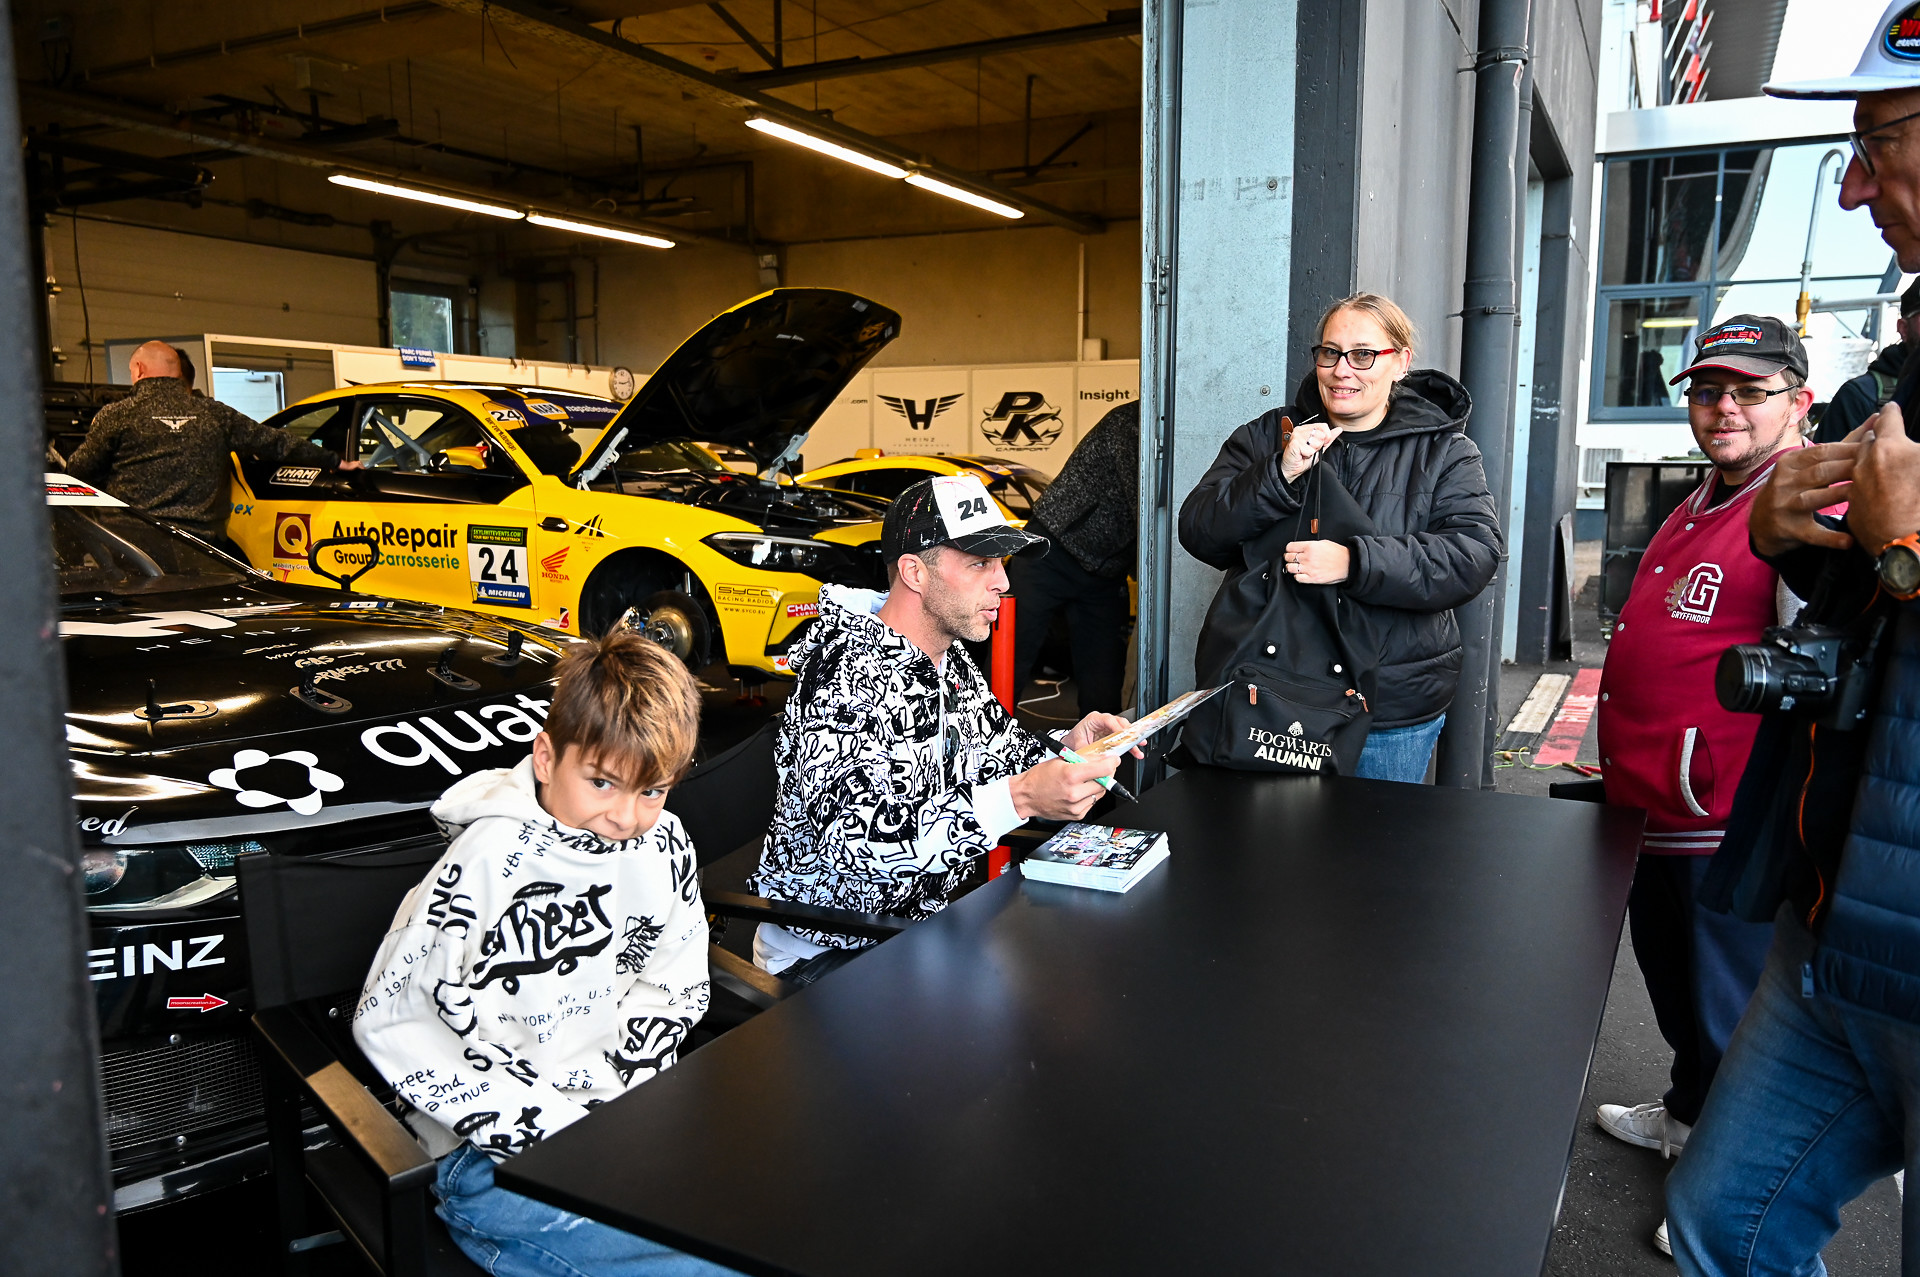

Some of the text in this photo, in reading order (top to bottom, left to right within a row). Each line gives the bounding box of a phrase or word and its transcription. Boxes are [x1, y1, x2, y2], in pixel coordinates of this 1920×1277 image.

[490, 409, 524, 422] 24
[276, 468, 319, 480] UMAMI
[957, 497, 988, 521] 24
[332, 520, 458, 552] AutoRepair
[378, 551, 460, 570] Carrosserie
[478, 546, 519, 584] 24
[541, 571, 570, 581] HONDA
[488, 588, 526, 599] MICHELIN
[1677, 562, 1724, 617] G
[1671, 610, 1711, 625] GRYFFINDOR
[295, 655, 335, 668] GAS
[1247, 727, 1332, 757] HOGWARTS
[1254, 744, 1323, 771] ALUMNI
[81, 806, 139, 836] ed
[425, 1081, 490, 1112] aenue
